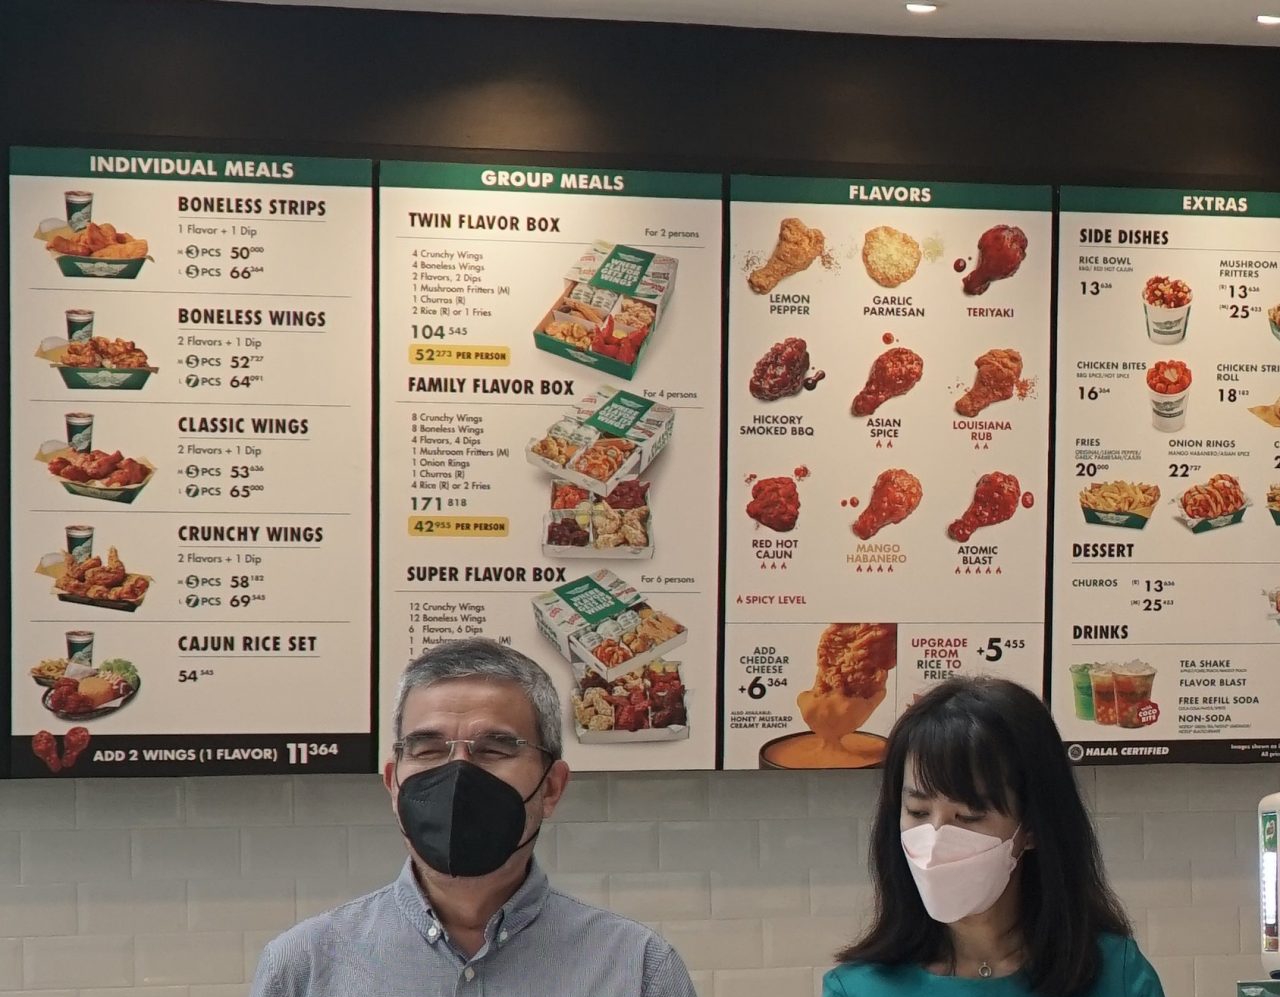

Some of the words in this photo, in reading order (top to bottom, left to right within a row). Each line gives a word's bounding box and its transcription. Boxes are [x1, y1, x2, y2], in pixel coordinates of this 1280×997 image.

[90, 156, 217, 176] INDIVIDUAL
[225, 160, 294, 179] MEALS
[481, 170, 554, 188] GROUP
[560, 172, 625, 190] MEALS
[849, 185, 932, 202] FLAVORS
[178, 197, 262, 214] BONELESS
[269, 199, 327, 216] STRIPS
[1182, 196, 1248, 212] EXTRAS
[408, 213, 451, 228] TWIN
[458, 214, 519, 231] FLAVOR
[526, 216, 560, 233] BOX
[645, 229, 658, 237] For
[659, 229, 666, 237] 2
[668, 231, 699, 240] persons
[1080, 228, 1112, 244] SIDE
[1118, 229, 1169, 245] DISHES
[420, 250, 454, 261] Crunchy
[457, 251, 483, 263] Wings
[1079, 256, 1100, 265] RICE
[1103, 256, 1131, 265] BOWL
[1219, 260, 1278, 269] MUSHROOM
[1219, 269, 1259, 278] FRITTERS
[770, 294, 810, 304] LEMON
[873, 296, 912, 306] GARLIC
[770, 305, 810, 315] PEPPER
[863, 307, 925, 317] PARMESAN
[966, 308, 1014, 318] TERIYAKI
[178, 308, 262, 325] BONELESS
[269, 310, 326, 327] WINGS
[456, 351, 472, 360] PER
[474, 352, 507, 361] PERSON
[1077, 361, 1120, 370] CHICKEN
[1122, 361, 1147, 370] BITES
[1217, 364, 1258, 373] CHICKEN
[1217, 373, 1239, 382] ROLL
[408, 377, 466, 393] FAMILY
[473, 378, 533, 394] FLAVOR
[540, 380, 574, 396] BOX
[753, 415, 803, 425] HICKORY
[867, 418, 901, 428] ASIAN
[953, 420, 1012, 430] LOUISIANA
[178, 417, 245, 433] CLASSIC
[251, 418, 309, 434] WINGS
[740, 426, 788, 436] SMOKED
[790, 426, 814, 437] BBQ
[870, 429, 899, 438] SPICE
[971, 431, 992, 441] RUB
[1076, 438, 1100, 447] FRIES
[1169, 439, 1203, 448] ONION
[1206, 439, 1236, 448] RINGS
[178, 525, 260, 541] CRUNCHY
[266, 526, 323, 542] WINGS
[752, 539, 772, 549] RED
[776, 540, 798, 549] HOT
[856, 544, 900, 553] MANGO
[756, 550, 793, 560] CAJUN
[958, 546, 998, 555] ATOMIC
[1073, 543, 1134, 558] DESSERT
[846, 554, 907, 564] HABANERO
[962, 556, 993, 565] BLAST
[407, 567, 459, 583] SUPER
[465, 567, 526, 583] FLAVOR
[533, 568, 567, 583] BOX
[1072, 579, 1118, 587] CHURROS
[745, 596, 775, 604] SPICY
[778, 596, 806, 604] LEVEL
[1073, 625, 1128, 640] DRINKS
[178, 636, 235, 651] CAJUN
[243, 636, 280, 651] RICE
[289, 636, 317, 651] SET
[912, 638, 968, 648] UPGRADE
[753, 647, 776, 655] ADD
[924, 649, 959, 659] FROM
[740, 655, 789, 665] CHEDDAR
[917, 660, 942, 669] RICE
[946, 660, 961, 669] TO
[1180, 660, 1197, 668] TEA
[1200, 660, 1231, 668] SHAKE
[745, 665, 783, 674] CHEESE
[1179, 679, 1217, 687] FLAVOR
[1219, 678, 1246, 687] BLAST
[1178, 696, 1201, 704] FREE
[1203, 696, 1231, 704] REFILL
[1233, 696, 1259, 704] SODA
[1178, 714, 1232, 722] NON-SODA
[93, 750, 126, 762] ADD
[129, 750, 138, 761] 2
[143, 750, 196, 761] WINGS
[199, 749, 211, 763] (1
[216, 749, 278, 763] FLAVOR)
[1086, 747, 1119, 756] HALAL
[1121, 746, 1169, 755] CERTIFIED
